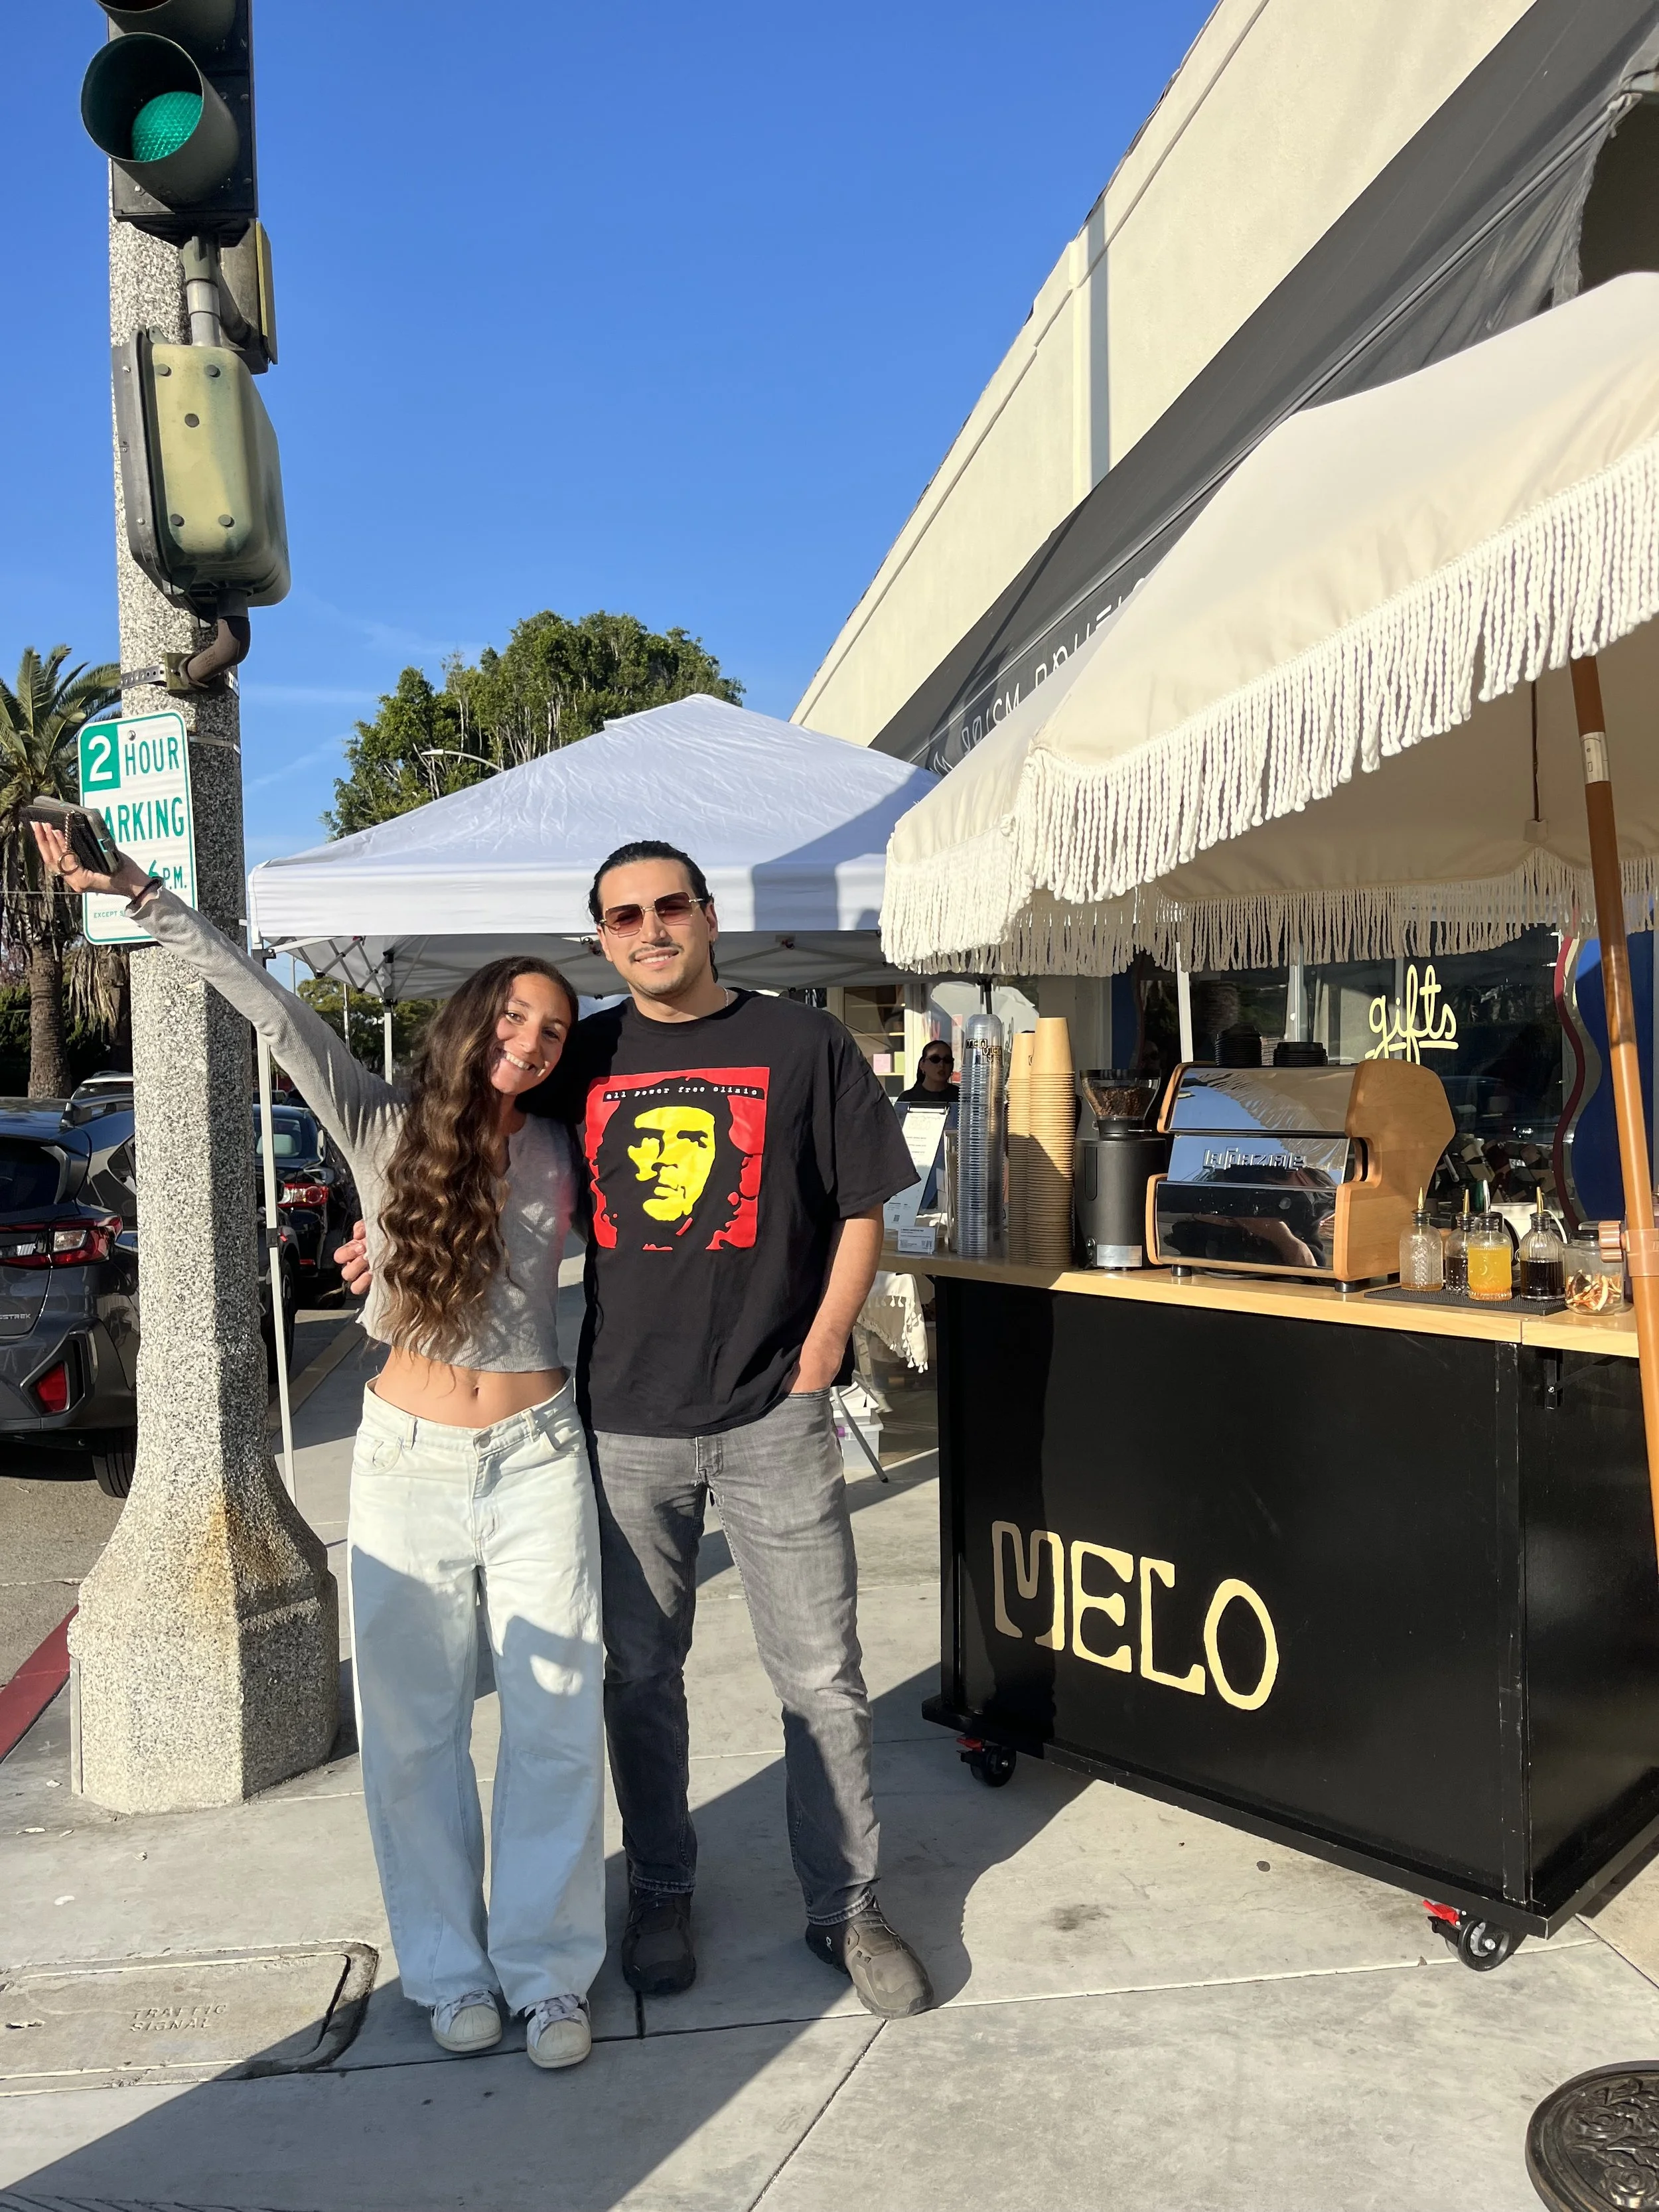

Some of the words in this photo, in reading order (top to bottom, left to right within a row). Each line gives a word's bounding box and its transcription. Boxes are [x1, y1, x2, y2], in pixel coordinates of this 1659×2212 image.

[88, 735, 113, 782] 2
[125, 737, 179, 776] HOUR
[104, 797, 184, 843] ARKING
[1368, 964, 1457, 1065] gifts
[606, 1090, 626, 1100] all
[634, 1087, 670, 1097] power
[713, 1086, 757, 1095] clinic
[991, 1520, 1279, 1710] MELO
[130, 2018, 211, 2031] SIGNAL
[134, 2004, 227, 2019] TRAFFIC
